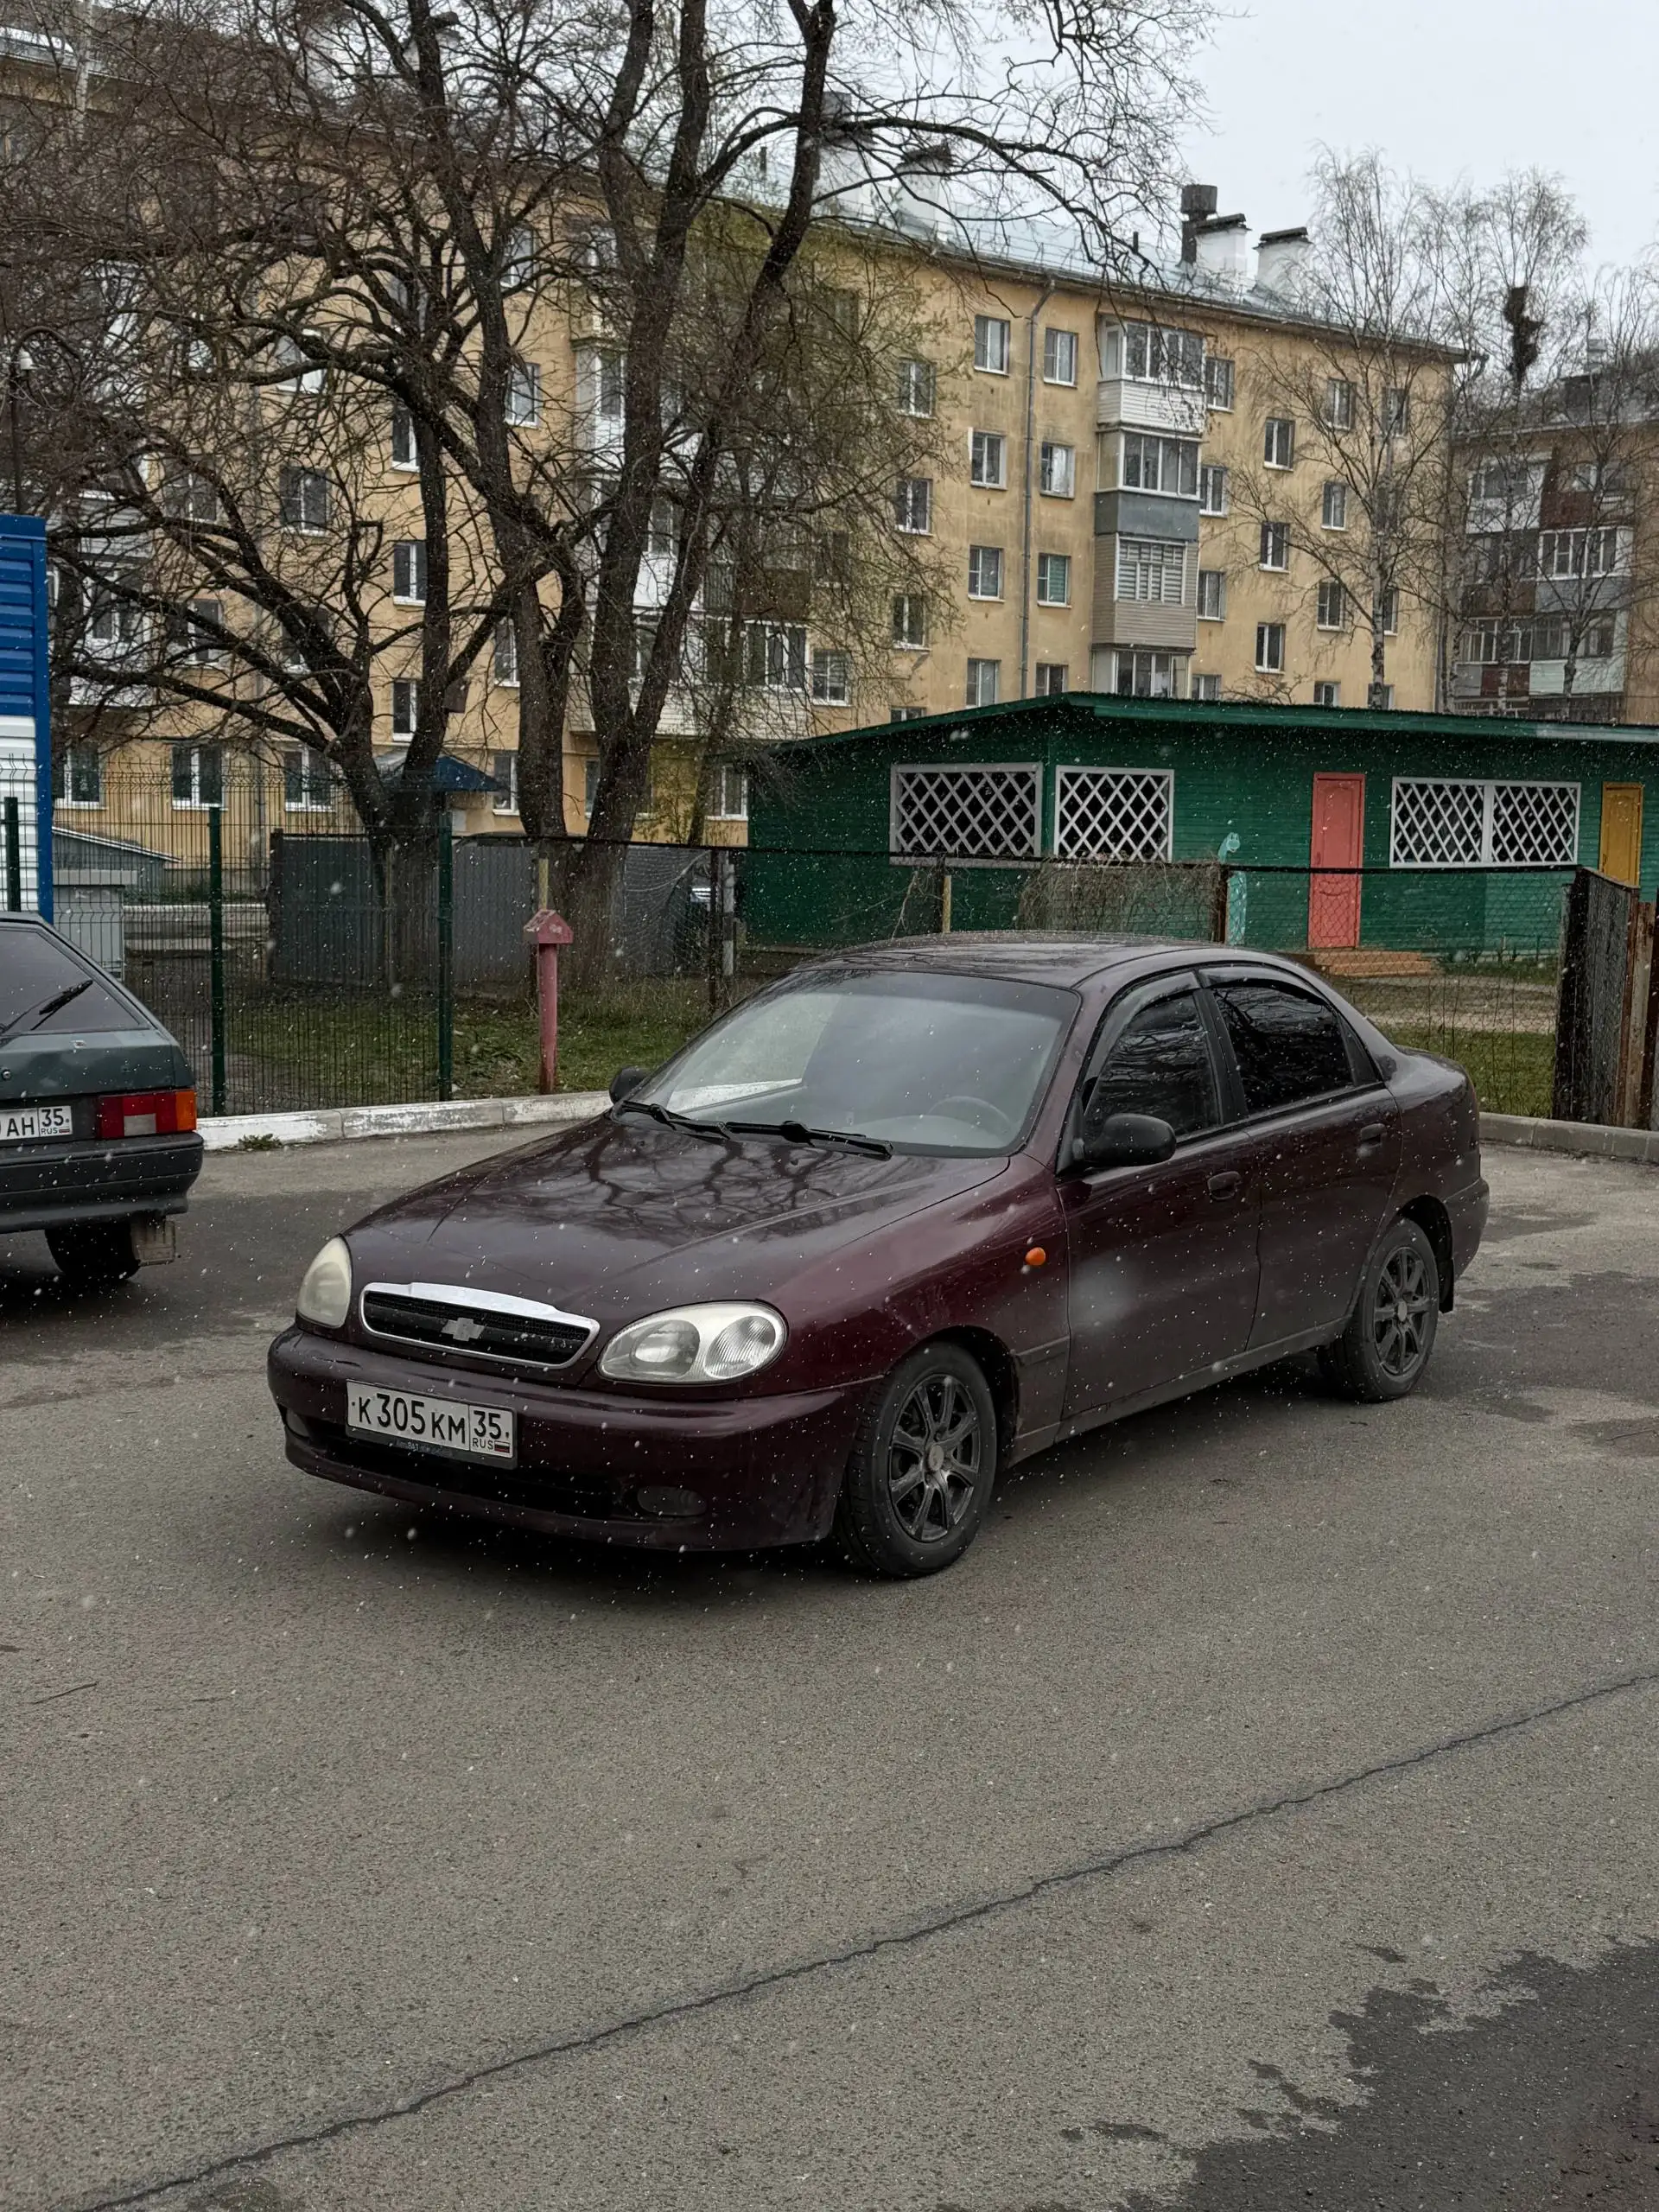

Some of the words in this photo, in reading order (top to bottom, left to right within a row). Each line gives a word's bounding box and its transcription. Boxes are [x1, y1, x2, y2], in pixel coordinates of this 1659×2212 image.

[0, 1116, 35, 1137] АН
[41, 1108, 64, 1127] 35
[359, 1393, 466, 1444] К305КМ
[474, 1411, 501, 1440] 35
[473, 1438, 493, 1450] RUS
